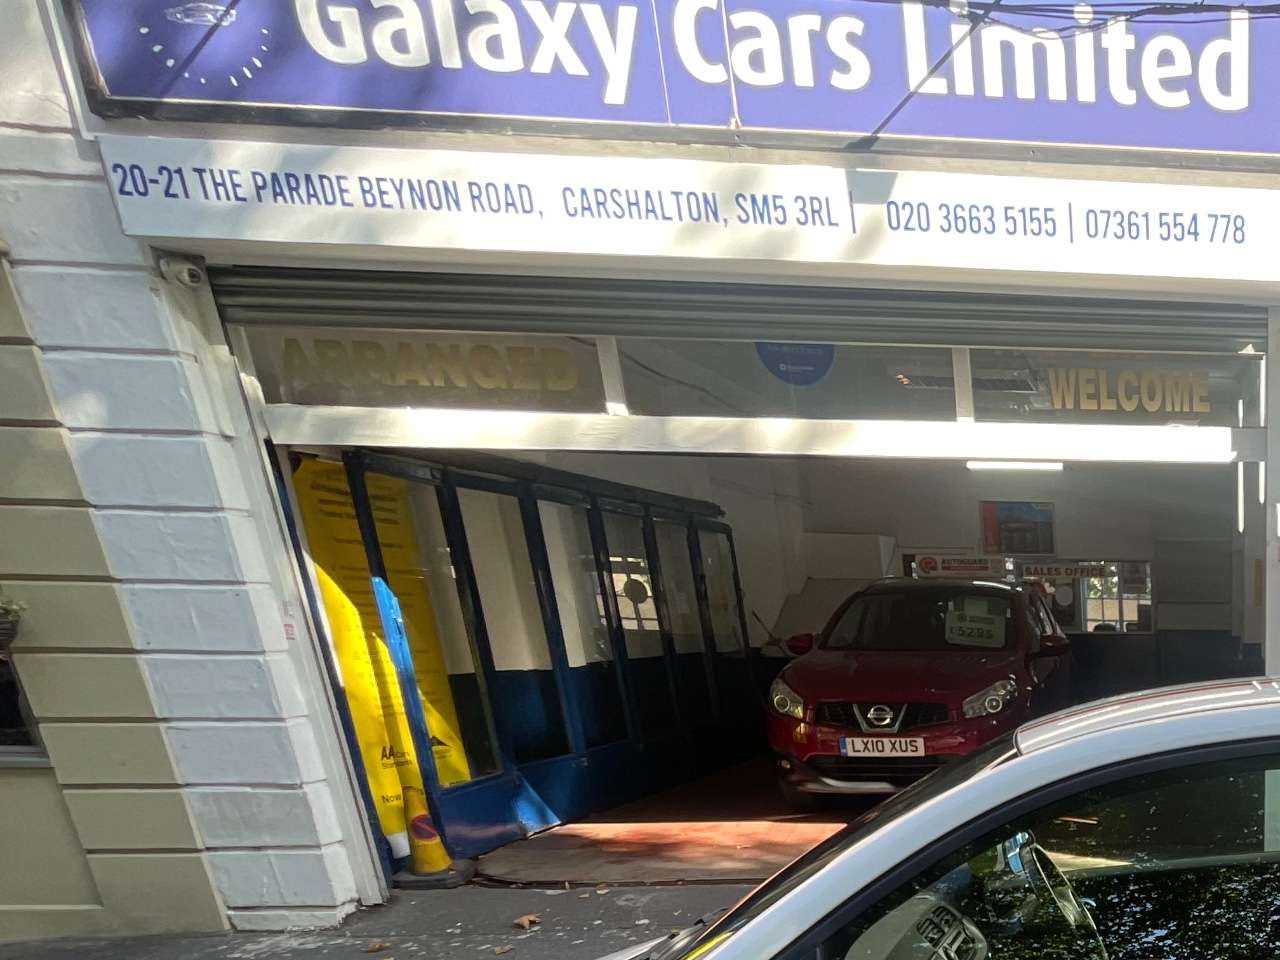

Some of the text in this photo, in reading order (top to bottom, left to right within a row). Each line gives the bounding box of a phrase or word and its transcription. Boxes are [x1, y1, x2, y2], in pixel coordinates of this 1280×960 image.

[299, 0, 1250, 112] Galaxy Cars Limited
[112, 162, 1246, 245] 20-21 THE PARADE BEYNON ROAD, CARSHALTON, SM5 3RL 020 3663 5155 07361 554 778
[1048, 368, 1211, 413] WELCOME
[1024, 566, 1062, 577] SALES
[851, 739, 919, 753] LX10 XUS
